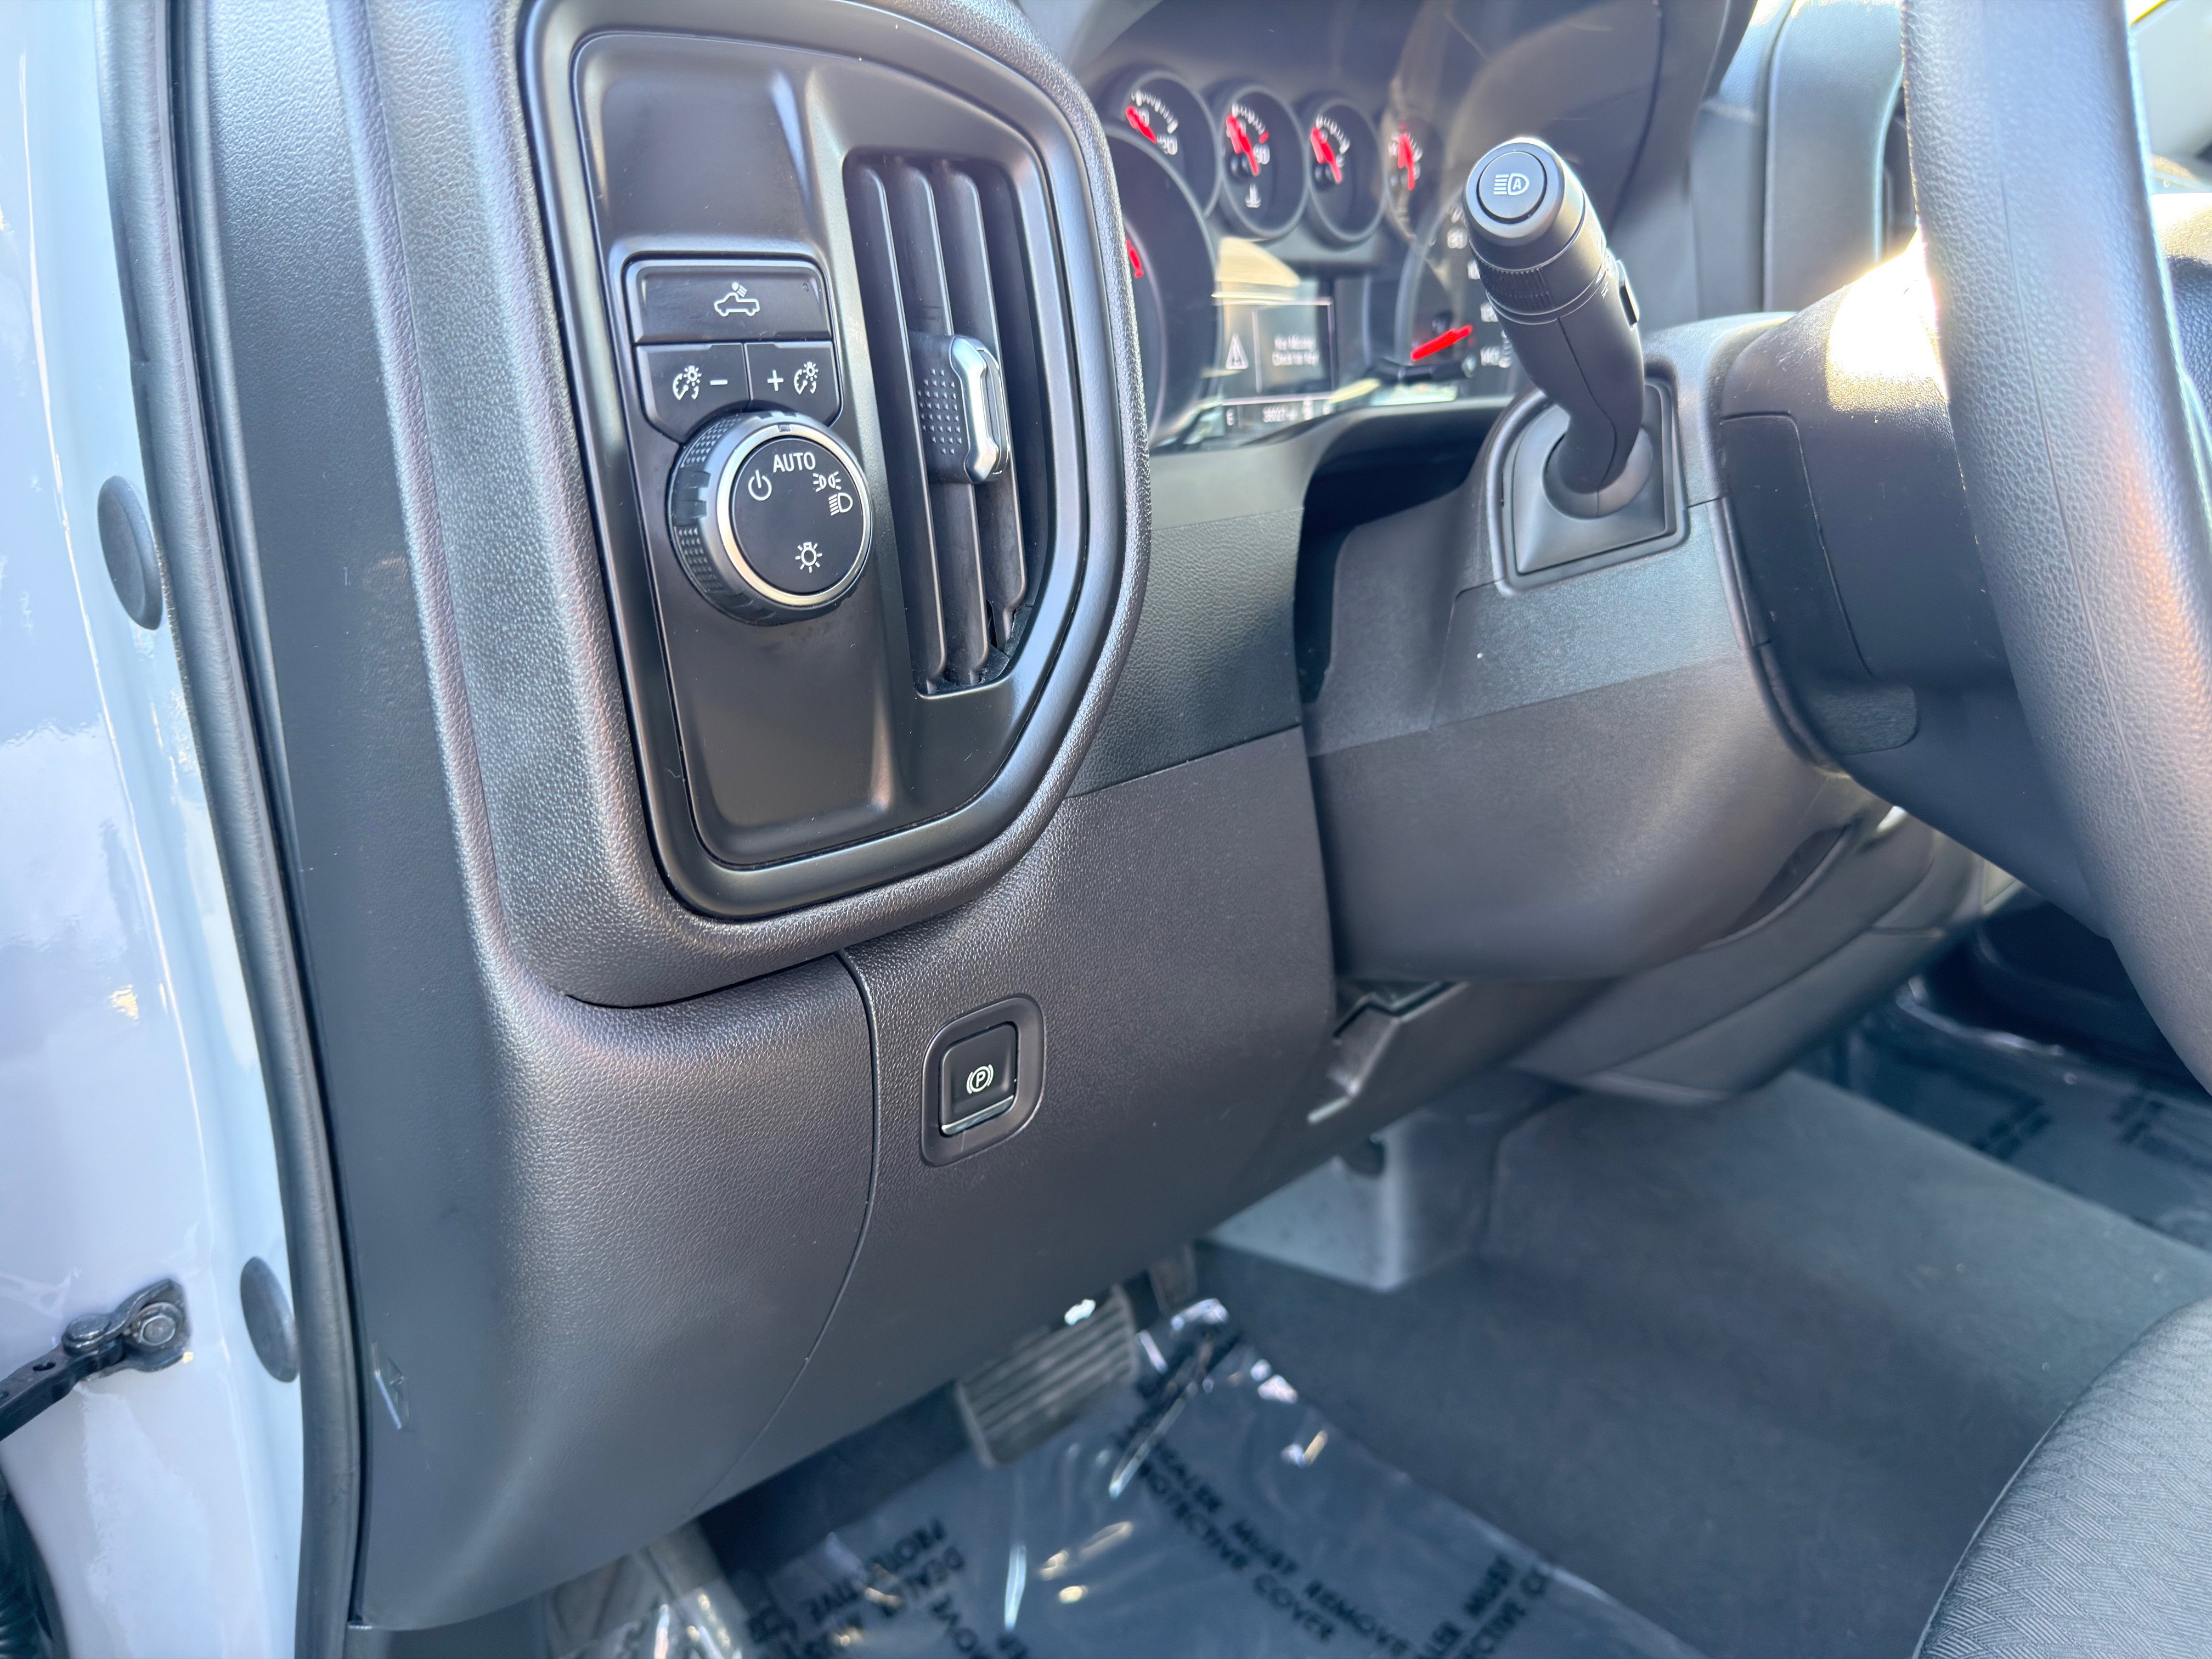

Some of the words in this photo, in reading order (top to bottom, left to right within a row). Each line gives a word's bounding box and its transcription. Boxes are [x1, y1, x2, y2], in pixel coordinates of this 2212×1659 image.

[1513, 177, 1522, 190] A
[773, 452, 816, 473] AUTO
[976, 1071, 986, 1087] P
[1252, 1572, 1335, 1643] COVER
